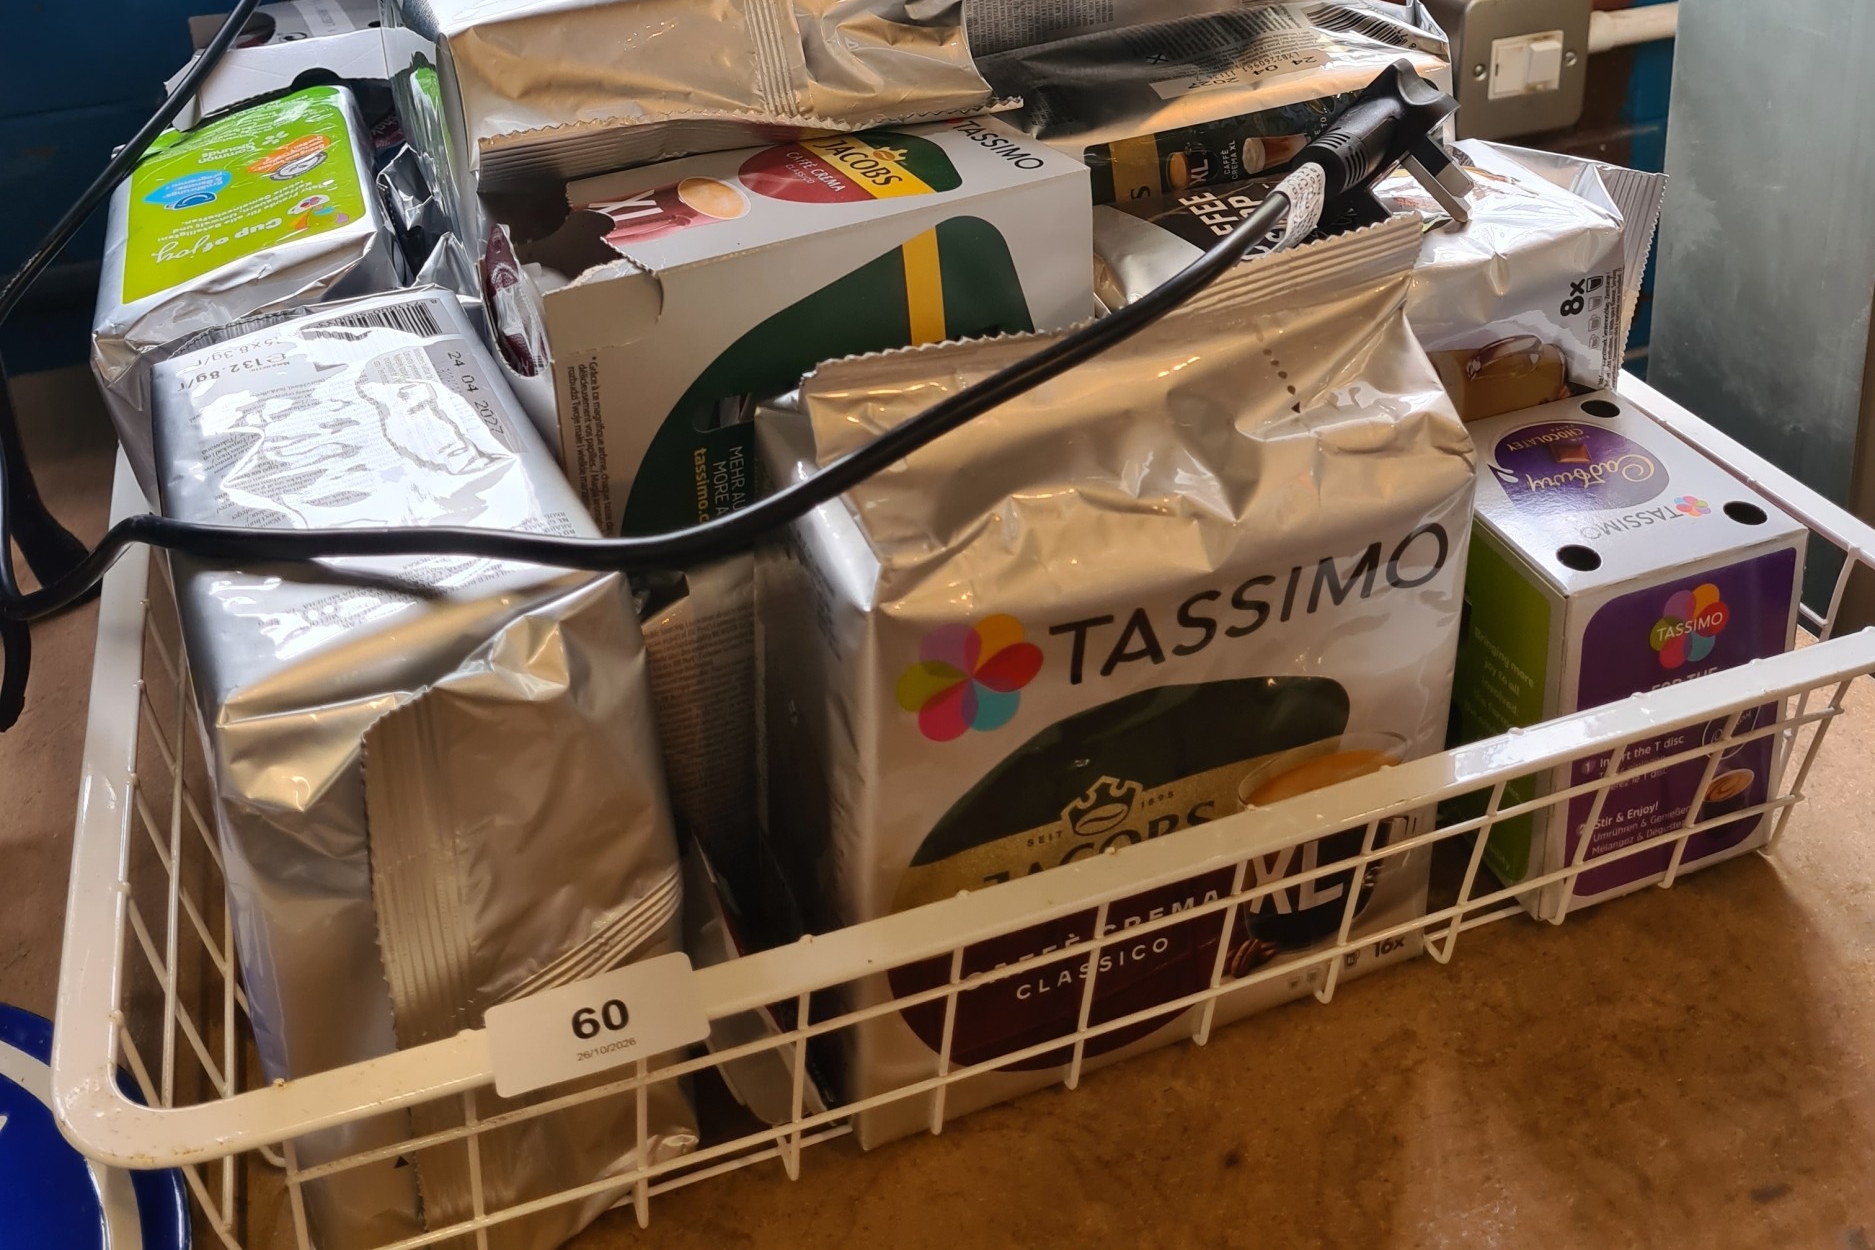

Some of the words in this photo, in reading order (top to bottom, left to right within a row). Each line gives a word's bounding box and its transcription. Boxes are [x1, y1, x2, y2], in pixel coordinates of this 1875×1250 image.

[1253, 64, 1279, 76] 04
[1290, 56, 1318, 66] 24
[952, 120, 1045, 171] TASSIMO
[785, 163, 817, 185] CLASSICO
[786, 150, 816, 175] CAFFÈ
[810, 167, 846, 193] CREMA
[813, 139, 903, 188] JACOBS
[1190, 158, 1209, 186] XL
[1222, 149, 1230, 175] CAFFÈ
[1231, 152, 1239, 180] CREMA
[234, 218, 282, 239] Cup
[151, 234, 211, 264] joy
[1560, 278, 1585, 317] 8x
[447, 351, 465, 367] 24
[461, 375, 479, 392] 04
[474, 400, 504, 434] 2027
[1507, 427, 1584, 452] CHOCOLATEY
[729, 446, 745, 490] MEHR
[1526, 454, 1655, 492] Cadbury
[713, 460, 730, 505] MORE
[1580, 505, 1683, 540] TASSIMO
[1048, 521, 1450, 686] TASSIMO
[1656, 611, 1724, 642] TASSIMO
[1509, 680, 1520, 697] all
[1510, 662, 1535, 688] more
[1634, 744, 1651, 758] the
[1655, 741, 1662, 752] T
[1663, 735, 1685, 749] disc
[1616, 812, 1625, 823] &
[1627, 801, 1659, 820] Enjoy!
[1027, 830, 1063, 848] SEIT
[1593, 822, 1638, 842] Umrühren
[1250, 841, 1344, 914] XL
[1375, 936, 1405, 958] 16x
[1017, 938, 1168, 999] CLASSICO
[571, 999, 630, 1039] 60
[576, 1037, 636, 1062] 26/10/2026
